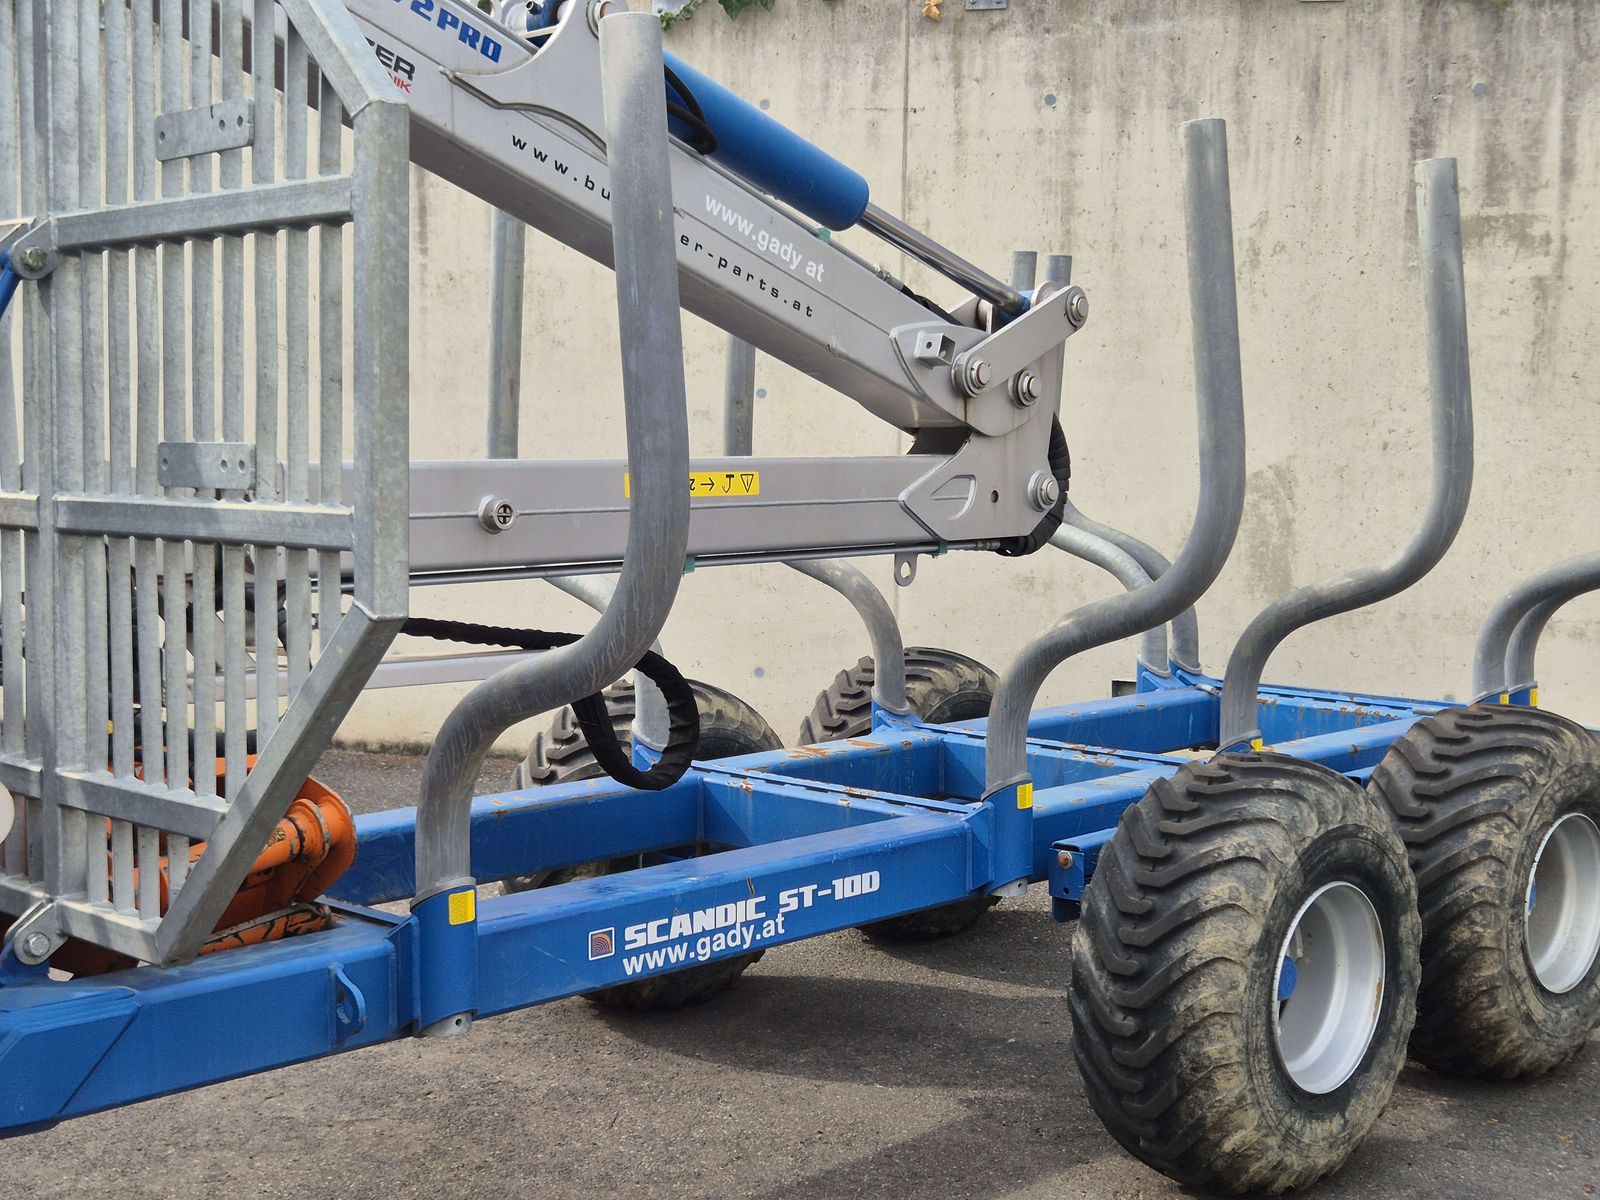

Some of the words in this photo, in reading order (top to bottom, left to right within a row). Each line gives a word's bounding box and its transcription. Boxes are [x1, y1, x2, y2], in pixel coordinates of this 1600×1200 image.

[365, 36, 416, 82] ER
[622, 912, 785, 976] www.gady.at
[624, 896, 766, 950] SCANDIC
